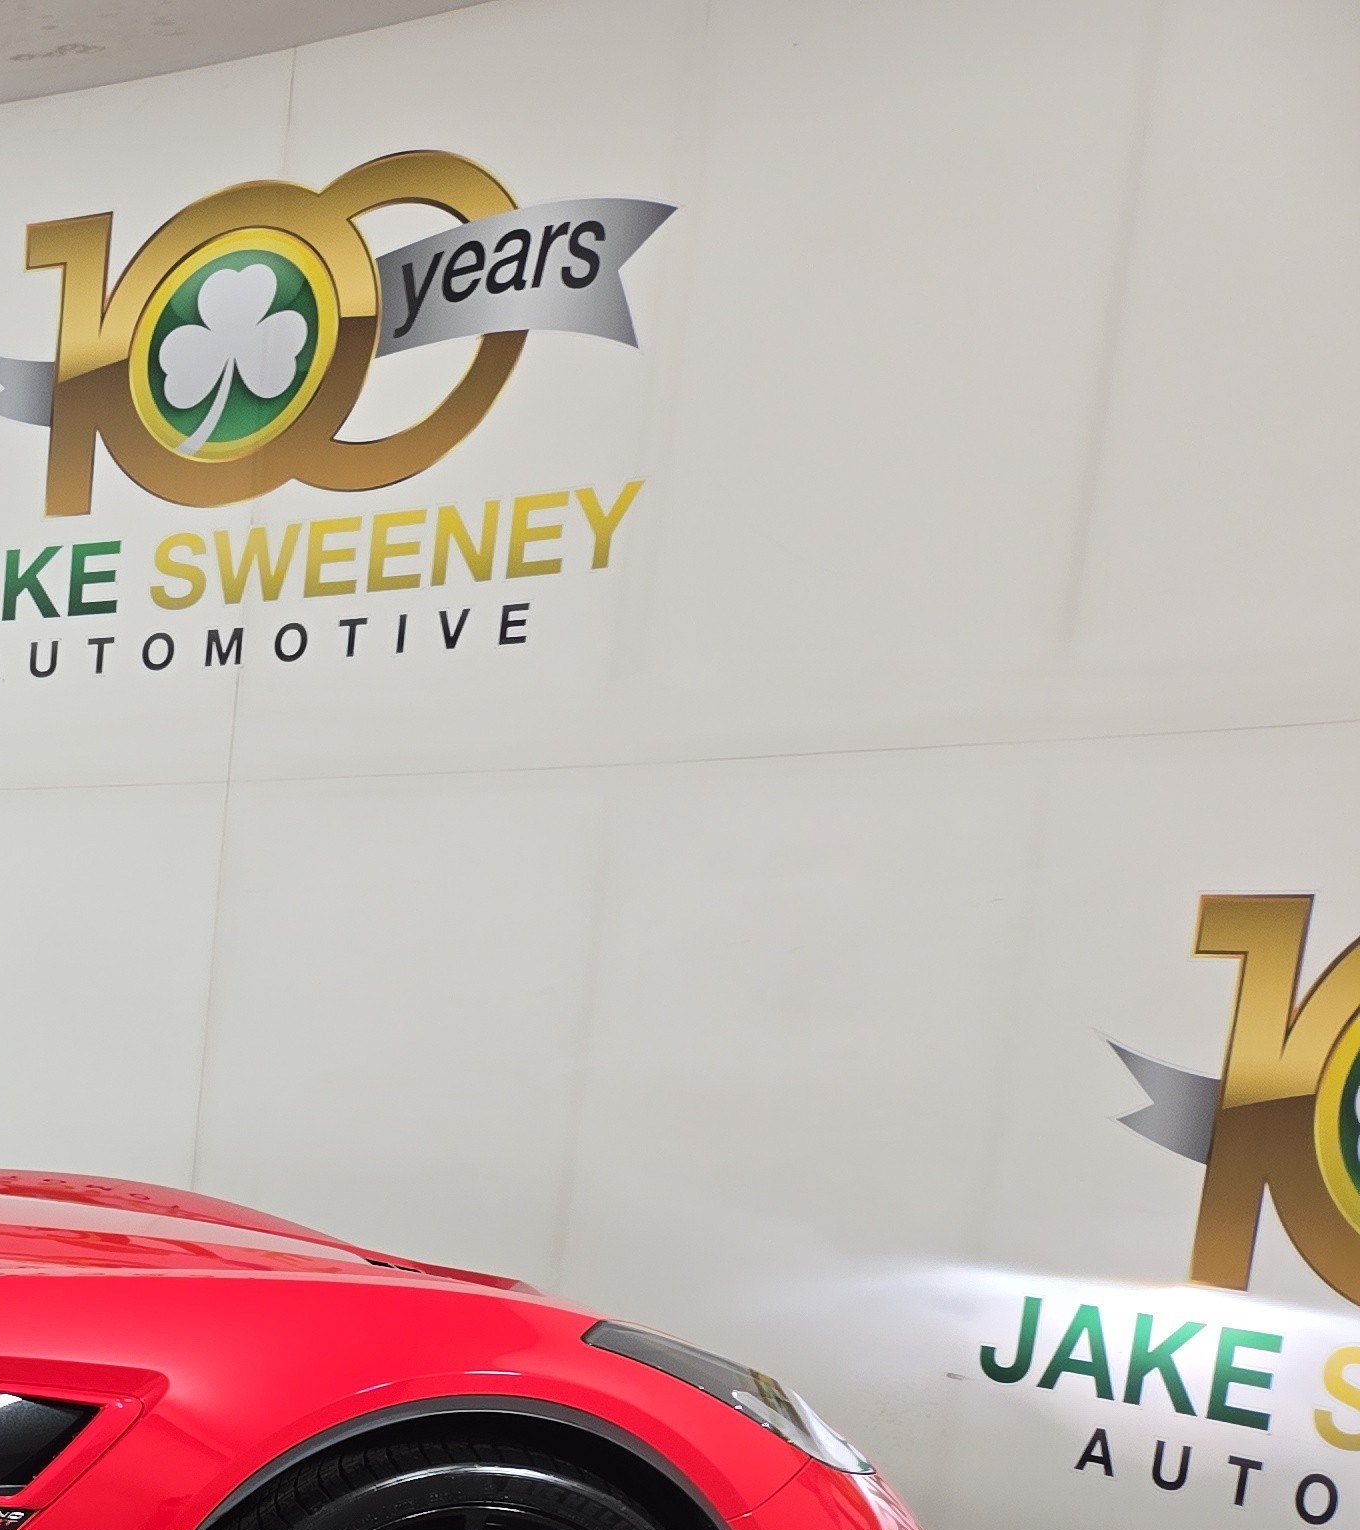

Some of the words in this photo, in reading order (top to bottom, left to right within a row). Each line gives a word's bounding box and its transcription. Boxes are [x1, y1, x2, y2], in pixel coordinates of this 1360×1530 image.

[24, 149, 528, 518] 100
[393, 219, 607, 338] years
[150, 480, 645, 611] SWEENEY
[980, 1295, 1284, 1432] JAKE
[1074, 1427, 1340, 1527] AUTO
